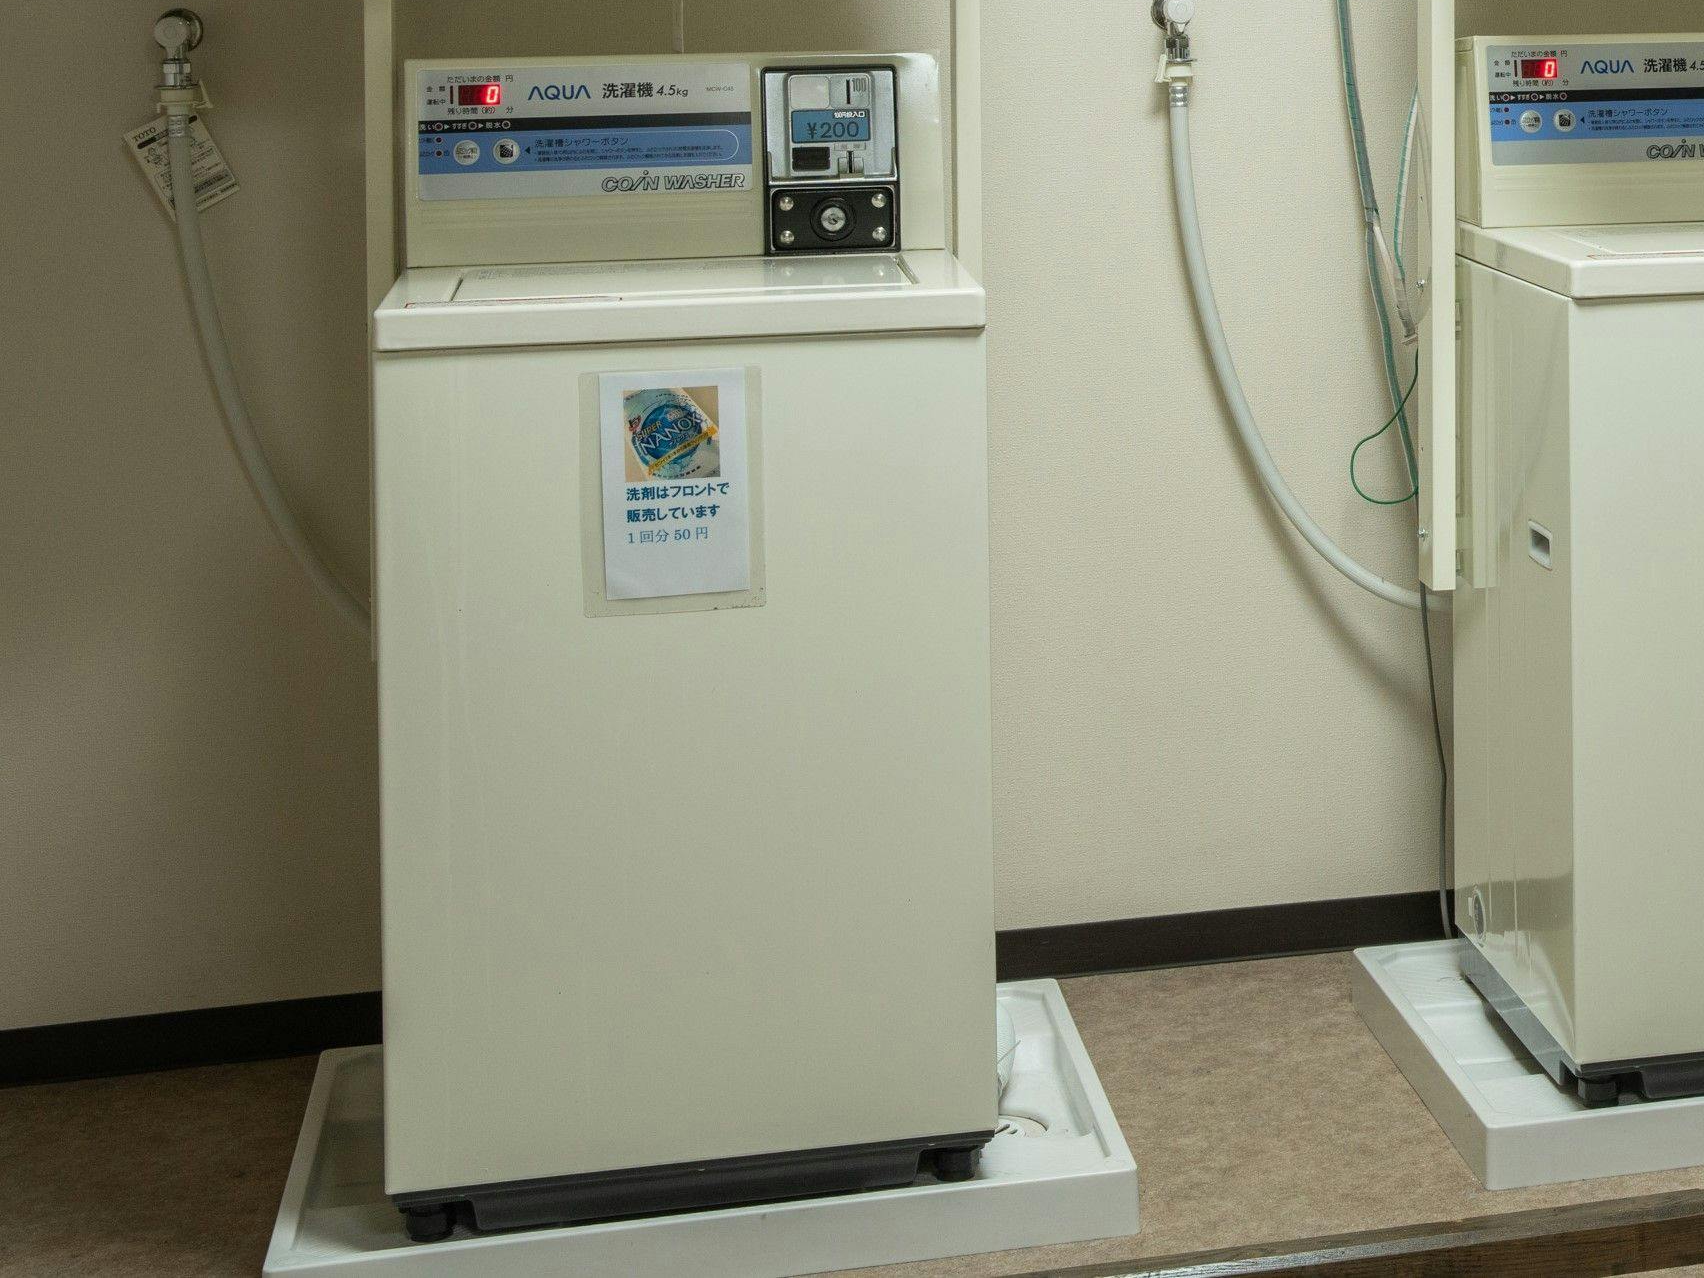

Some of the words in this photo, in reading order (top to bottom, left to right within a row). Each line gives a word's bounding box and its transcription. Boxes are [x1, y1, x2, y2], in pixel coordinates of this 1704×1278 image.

[1560, 49, 1568, 58] 円
[1544, 61, 1555, 78] 0
[1580, 59, 1635, 75] AQUA
[1643, 57, 1687, 73] 洗濯機
[505, 74, 513, 82] 円
[485, 85, 499, 104] 0
[527, 84, 592, 101] AQUA
[602, 82, 654, 99] 洗濯機
[656, 84, 689, 98] 4.5kg
[505, 106, 514, 114] 分
[806, 121, 859, 140] ¥200
[664, 172, 746, 190] WASHER
[640, 411, 703, 455] NANOX
[626, 482, 730, 502] 洗剤はフロントで
[627, 504, 720, 523] 販売しています
